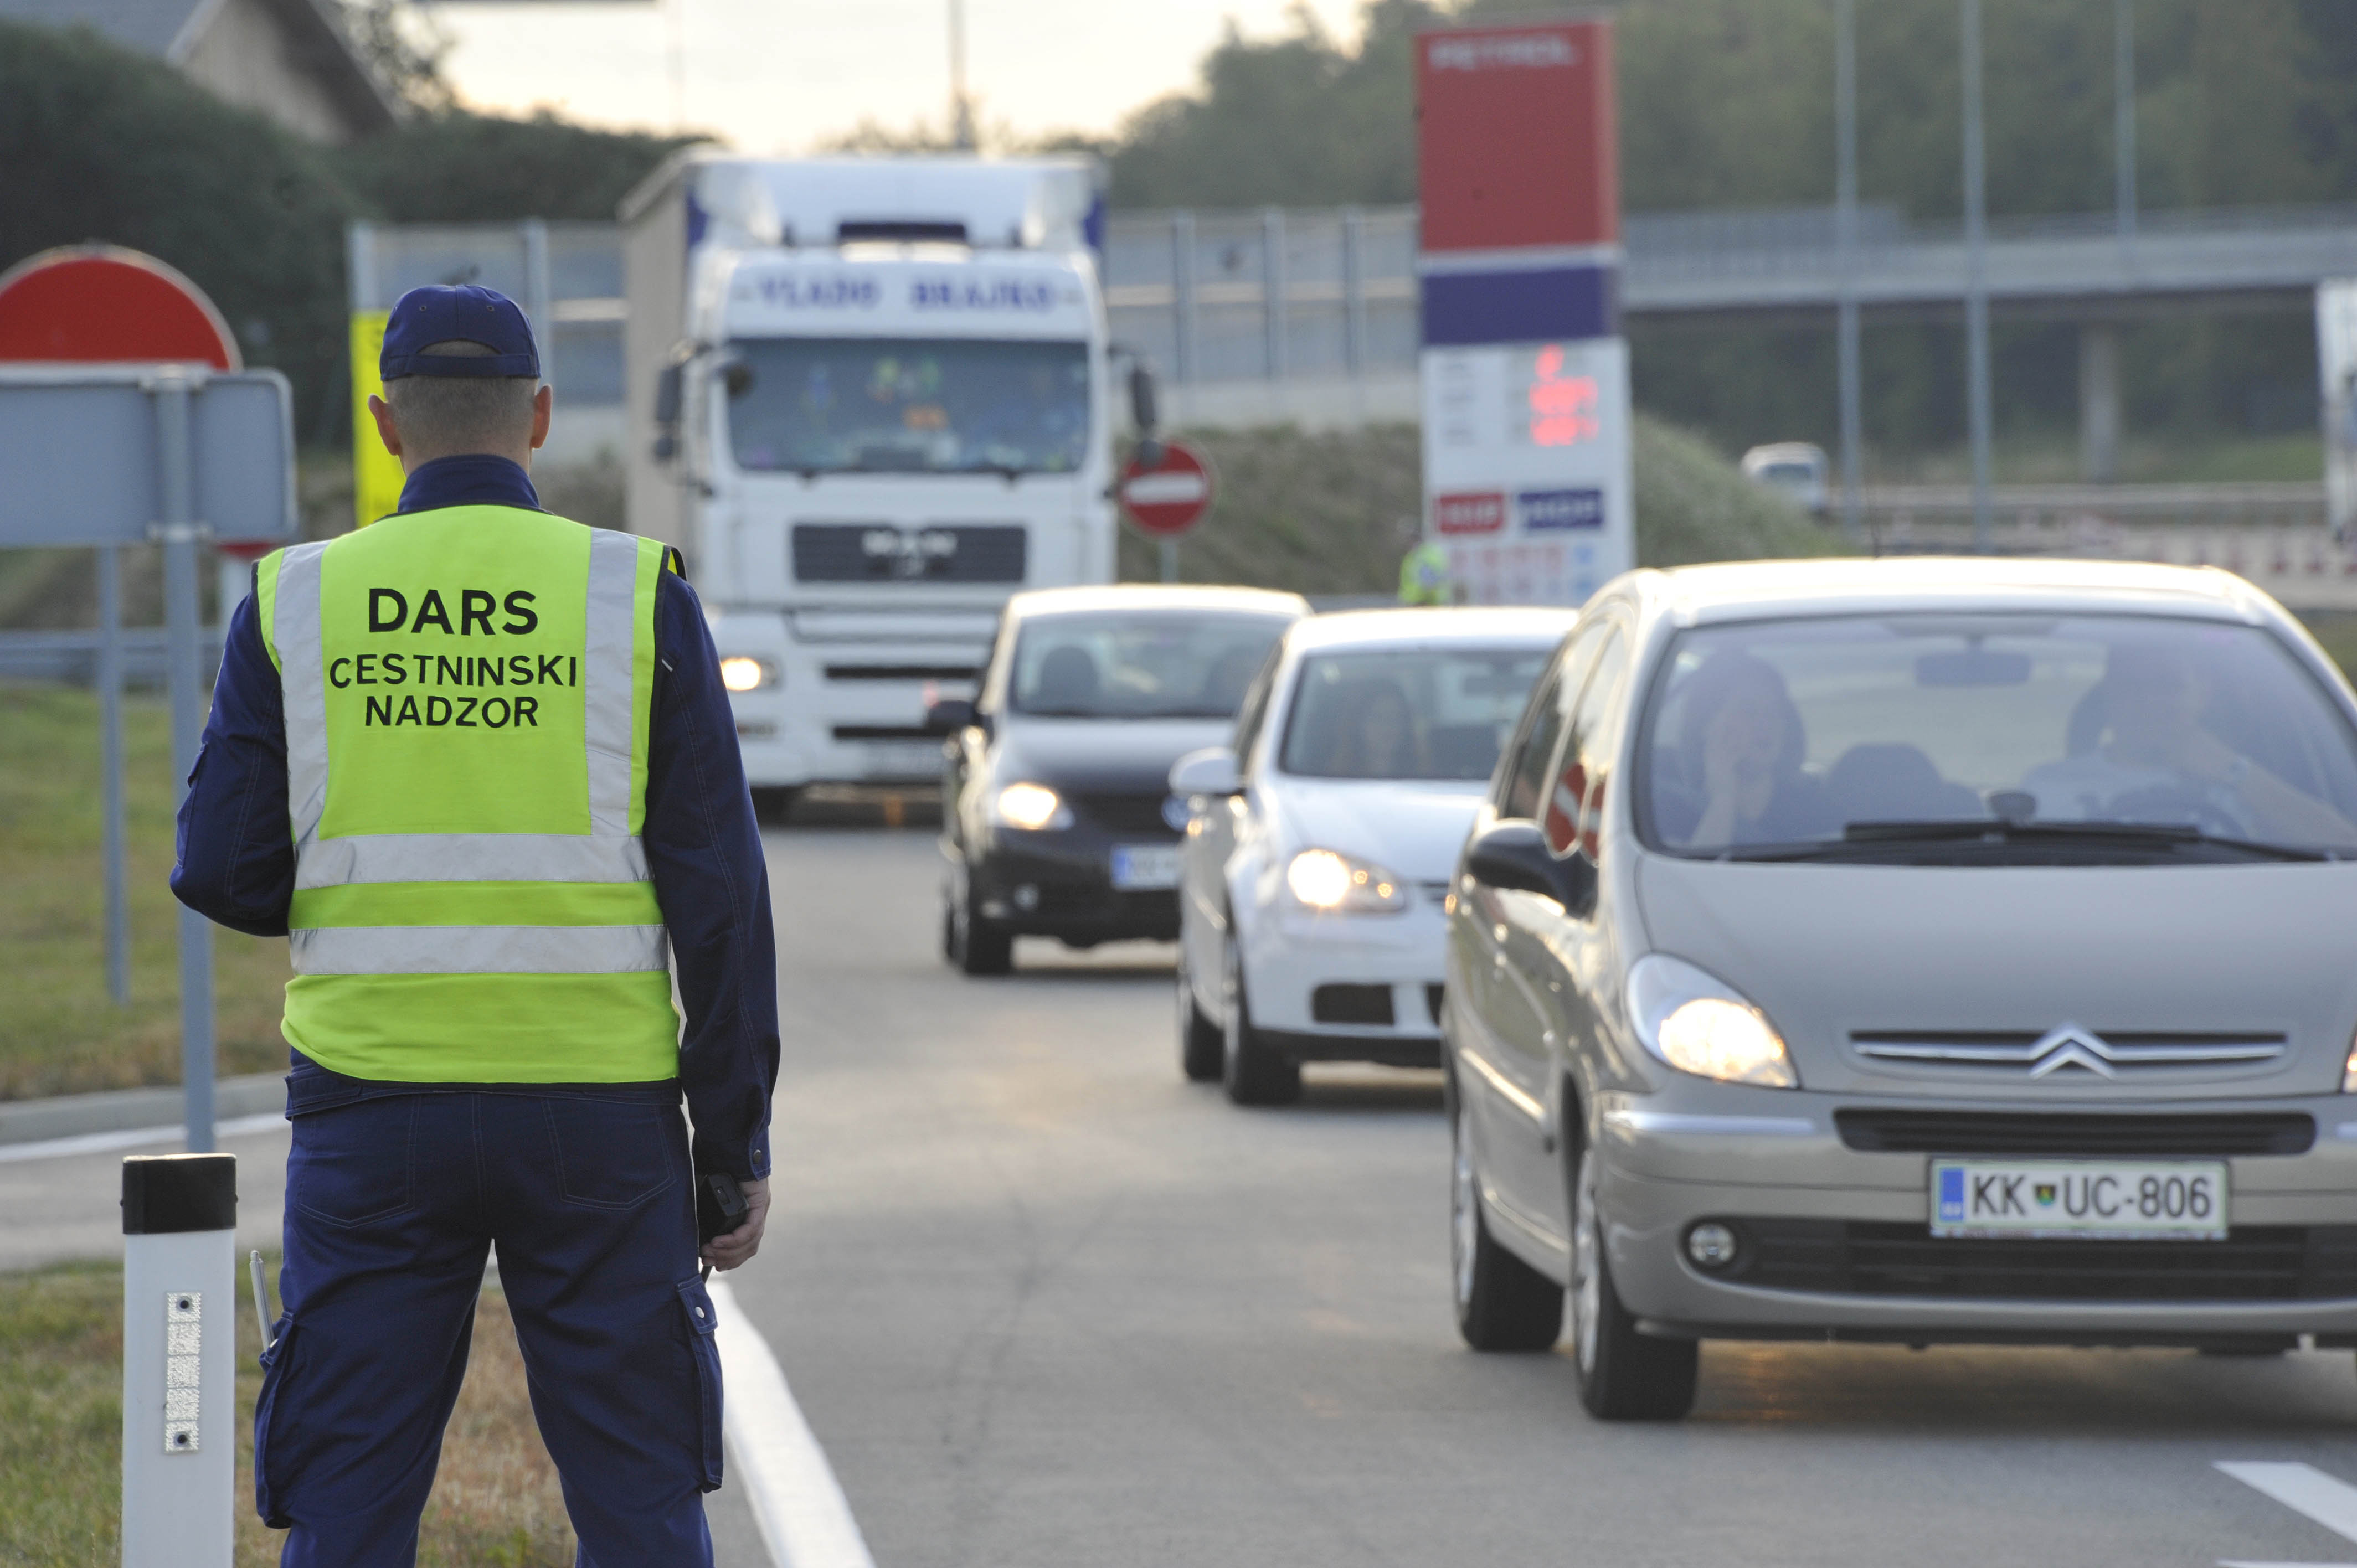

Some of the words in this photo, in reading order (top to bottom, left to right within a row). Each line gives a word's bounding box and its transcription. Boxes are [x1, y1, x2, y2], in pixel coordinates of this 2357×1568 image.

[369, 588, 538, 636] DARS
[330, 653, 577, 688] CESTNINSKI
[365, 695, 538, 728] NADZOR
[1973, 1174, 2027, 1216] KK
[2063, 1176, 2211, 1219] UC-806
